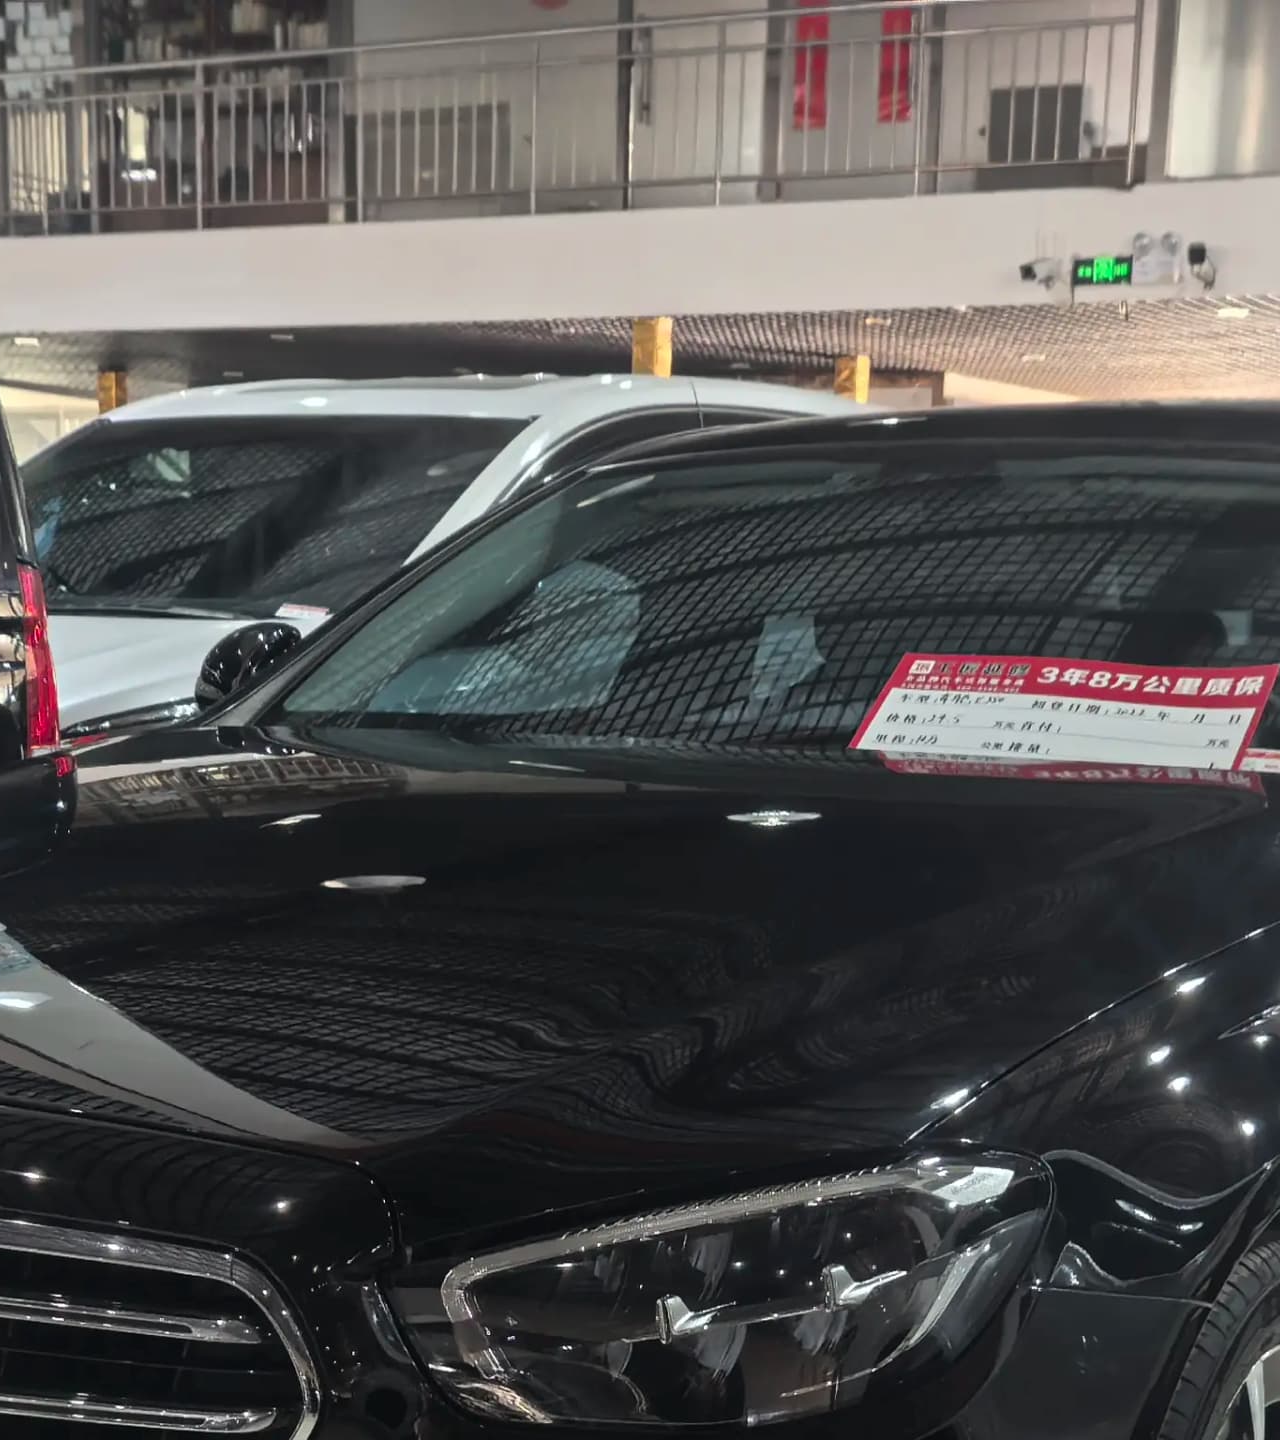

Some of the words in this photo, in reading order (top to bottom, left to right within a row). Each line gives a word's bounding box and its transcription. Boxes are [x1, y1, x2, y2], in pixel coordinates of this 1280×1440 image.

[1036, 666, 1265, 697] 3年8万公里质保
